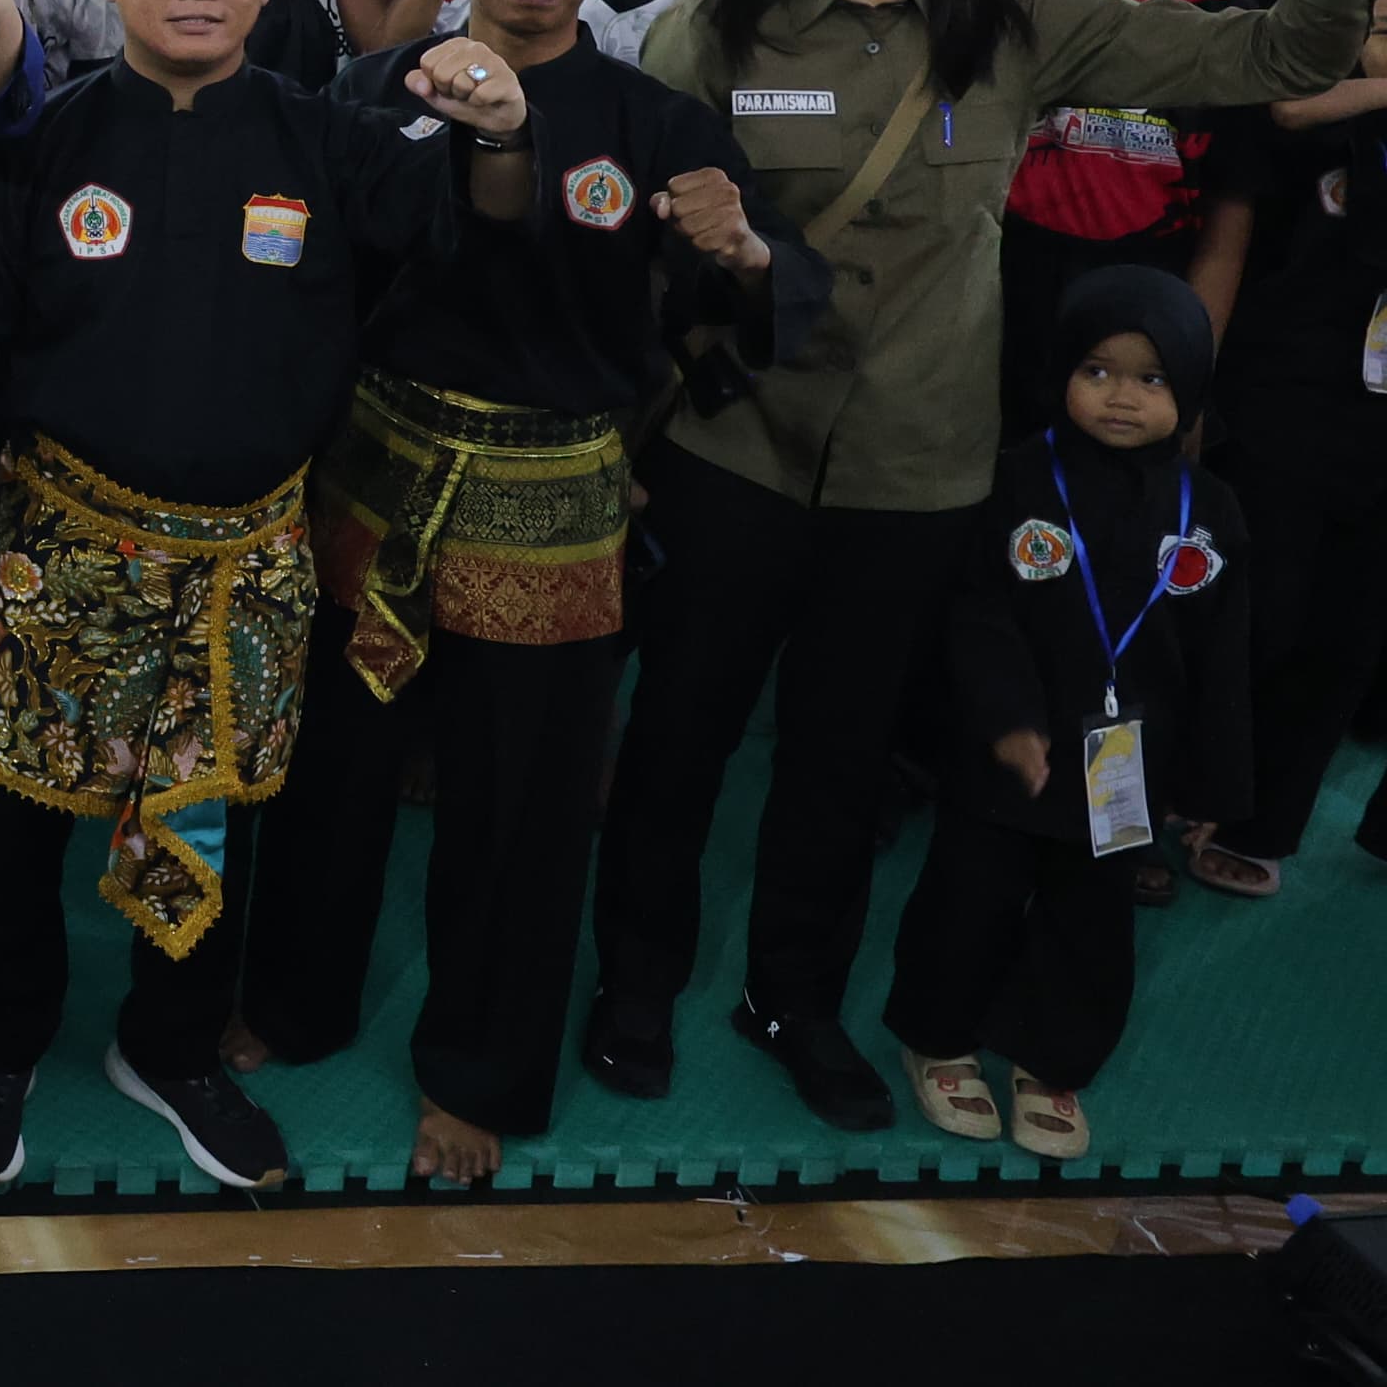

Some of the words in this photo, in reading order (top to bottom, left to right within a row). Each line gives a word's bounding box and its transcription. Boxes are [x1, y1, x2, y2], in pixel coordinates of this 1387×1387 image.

[737, 94, 830, 111] PARAMISWARI
[1087, 124, 1123, 138] IPSI
[78, 243, 117, 256] IPSI
[1027, 567, 1062, 581] IPSI
